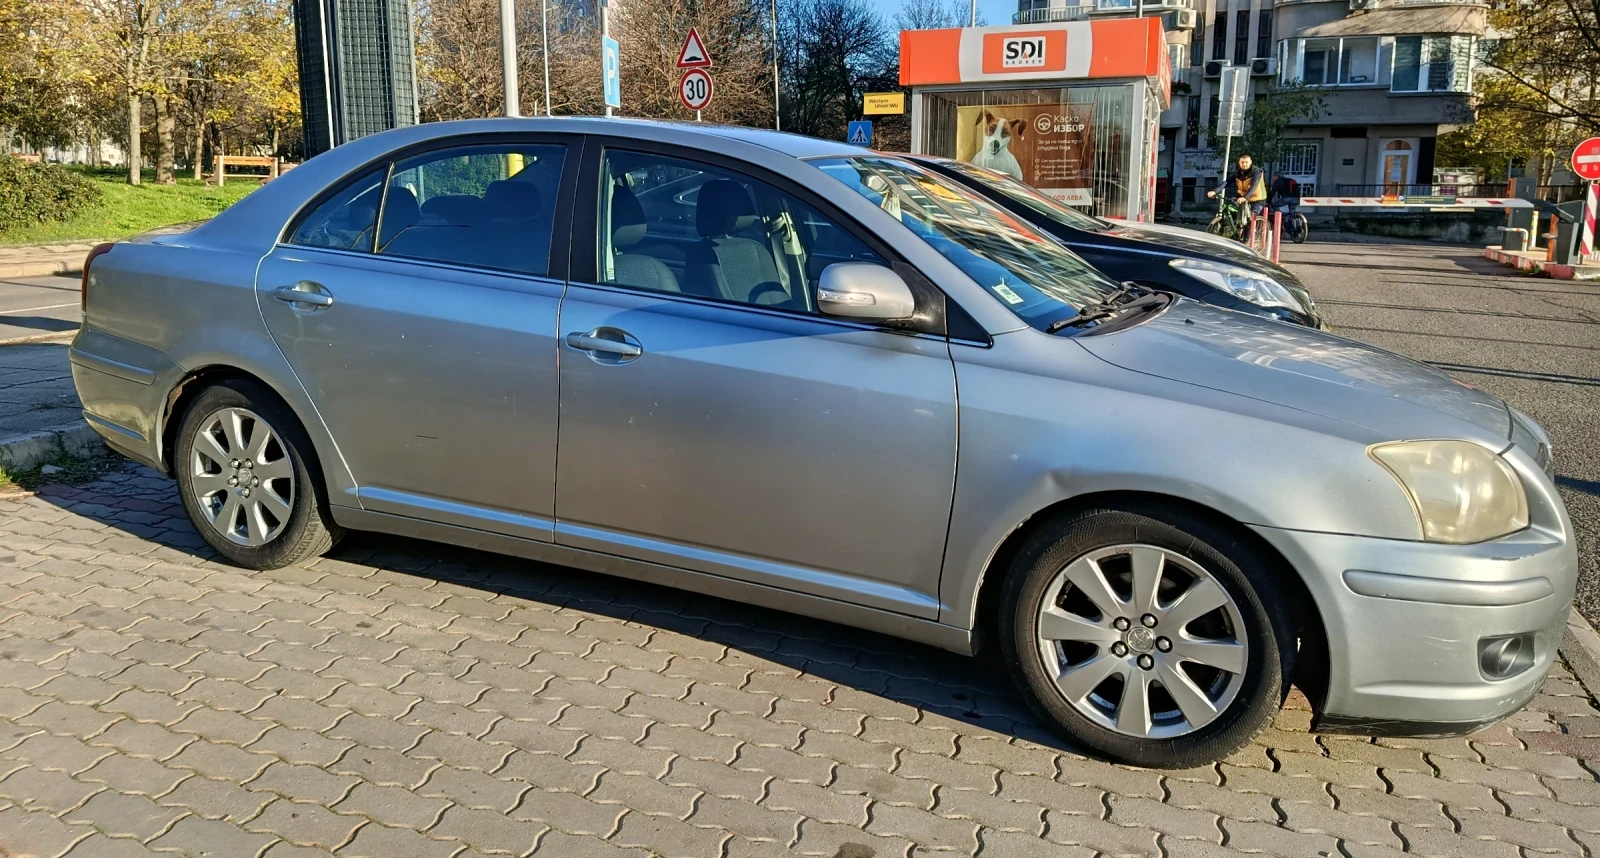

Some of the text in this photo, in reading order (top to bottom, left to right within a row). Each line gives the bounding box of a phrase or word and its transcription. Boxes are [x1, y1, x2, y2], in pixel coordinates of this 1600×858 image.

[1006, 40, 1042, 60] SDI
[606, 46, 616, 96] P
[686, 78, 706, 100] 30
[1054, 114, 1078, 123] Каско
[1054, 124, 1084, 132] ИЗБОР
